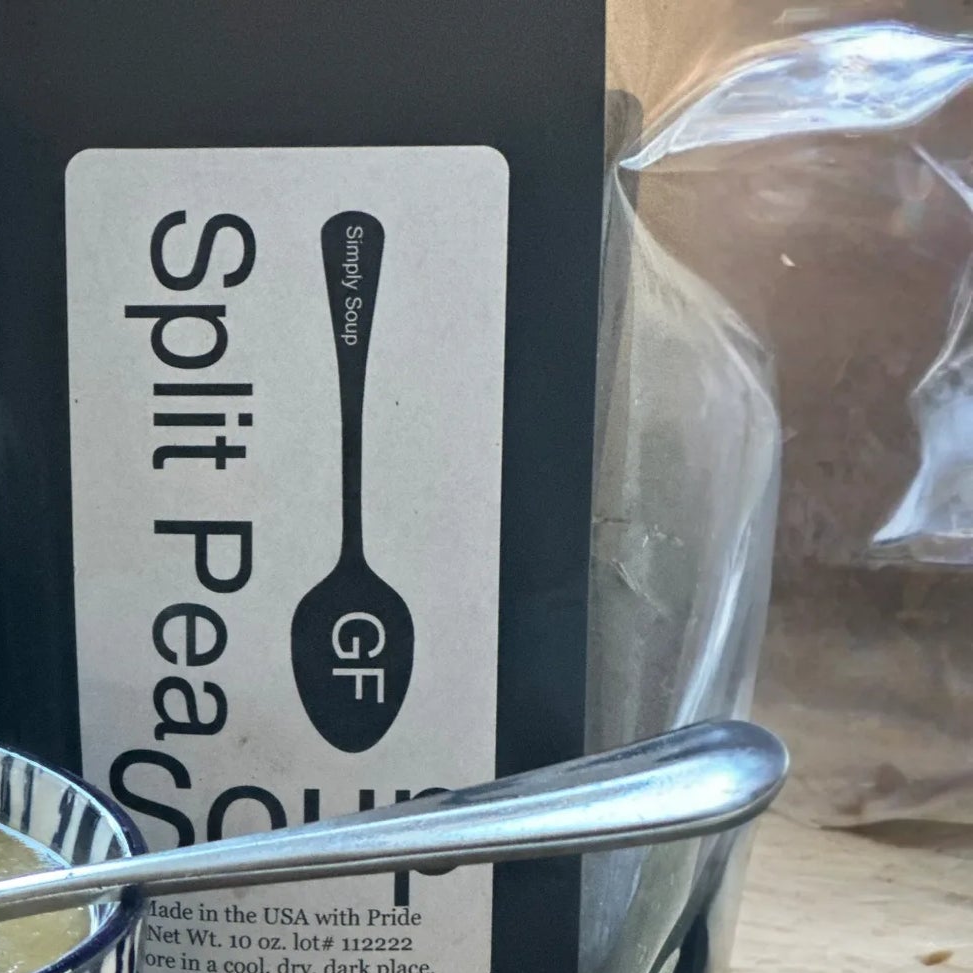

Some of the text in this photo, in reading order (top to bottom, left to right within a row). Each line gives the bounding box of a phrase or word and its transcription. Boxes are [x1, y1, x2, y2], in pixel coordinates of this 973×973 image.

[341, 226, 363, 346] Simply Soup
[124, 209, 256, 741] Split Pea
[332, 611, 386, 703] GF
[146, 925, 413, 951] Net Wt. 10 oz. lot# 112222
[199, 903, 218, 922] in
[224, 905, 257, 924] the
[264, 907, 310, 925] USA
[315, 908, 360, 926] with
[367, 908, 422, 926] Pride
[145, 953, 176, 969] ore
[181, 953, 201, 971] in
[207, 959, 218, 973] a
